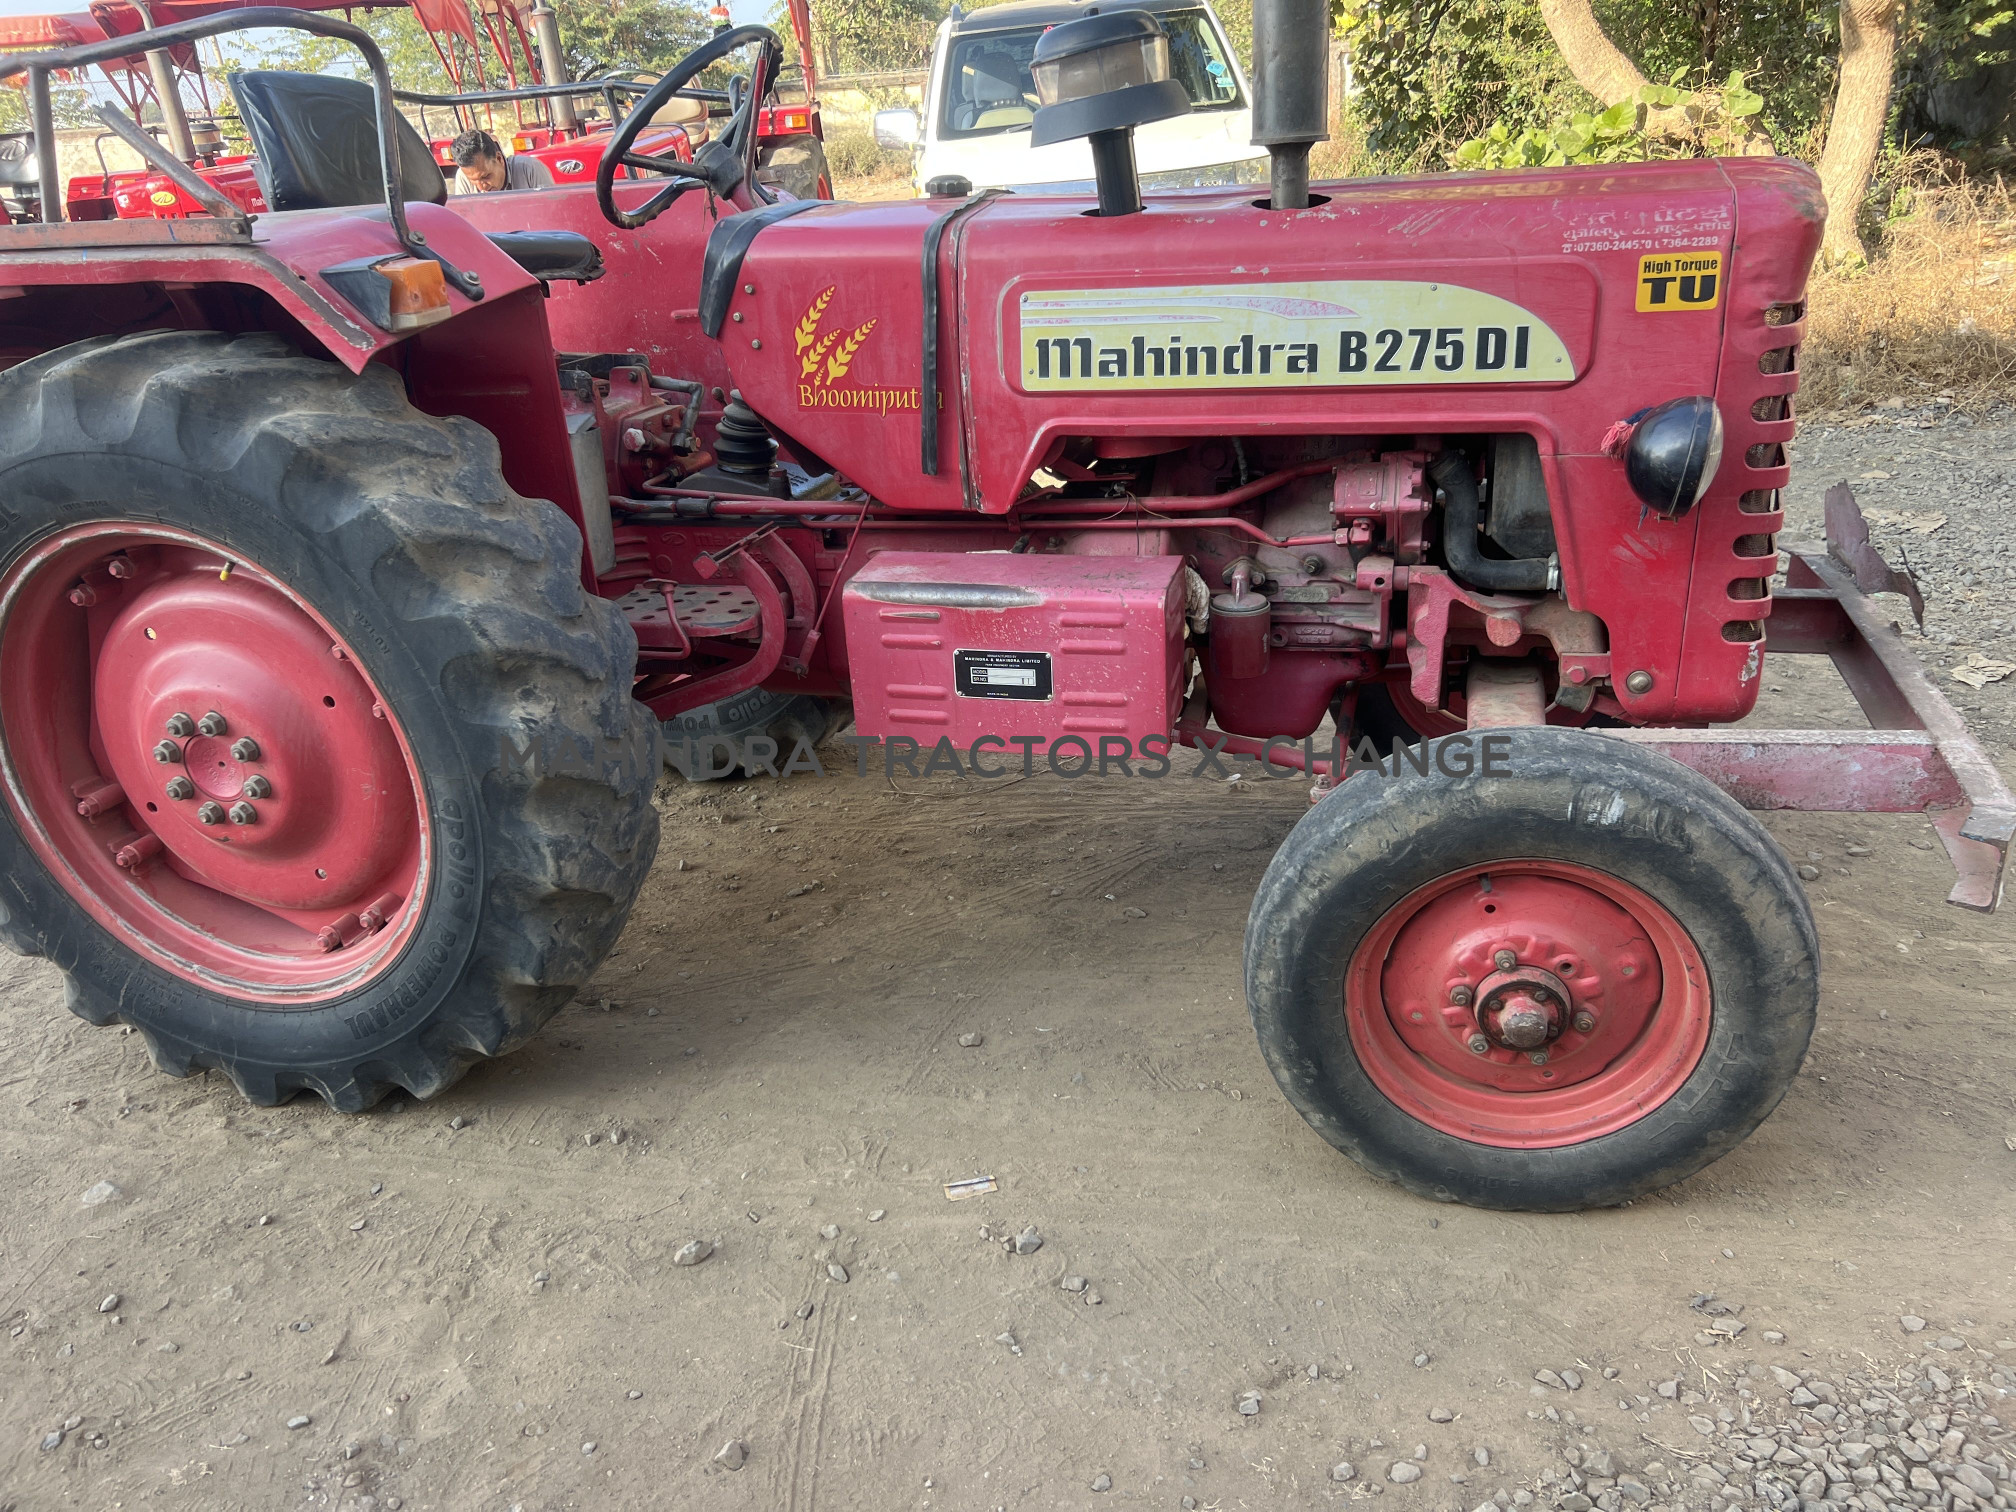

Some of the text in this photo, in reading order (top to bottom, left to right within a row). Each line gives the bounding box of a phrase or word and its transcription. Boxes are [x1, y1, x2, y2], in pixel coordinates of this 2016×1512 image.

[1642, 274, 1717, 305] TU
[1643, 259, 1718, 275] High Torque
[1035, 333, 1319, 379] Mahindra
[441, 797, 474, 899] apollo
[343, 921, 457, 1041] POWERHAUL
